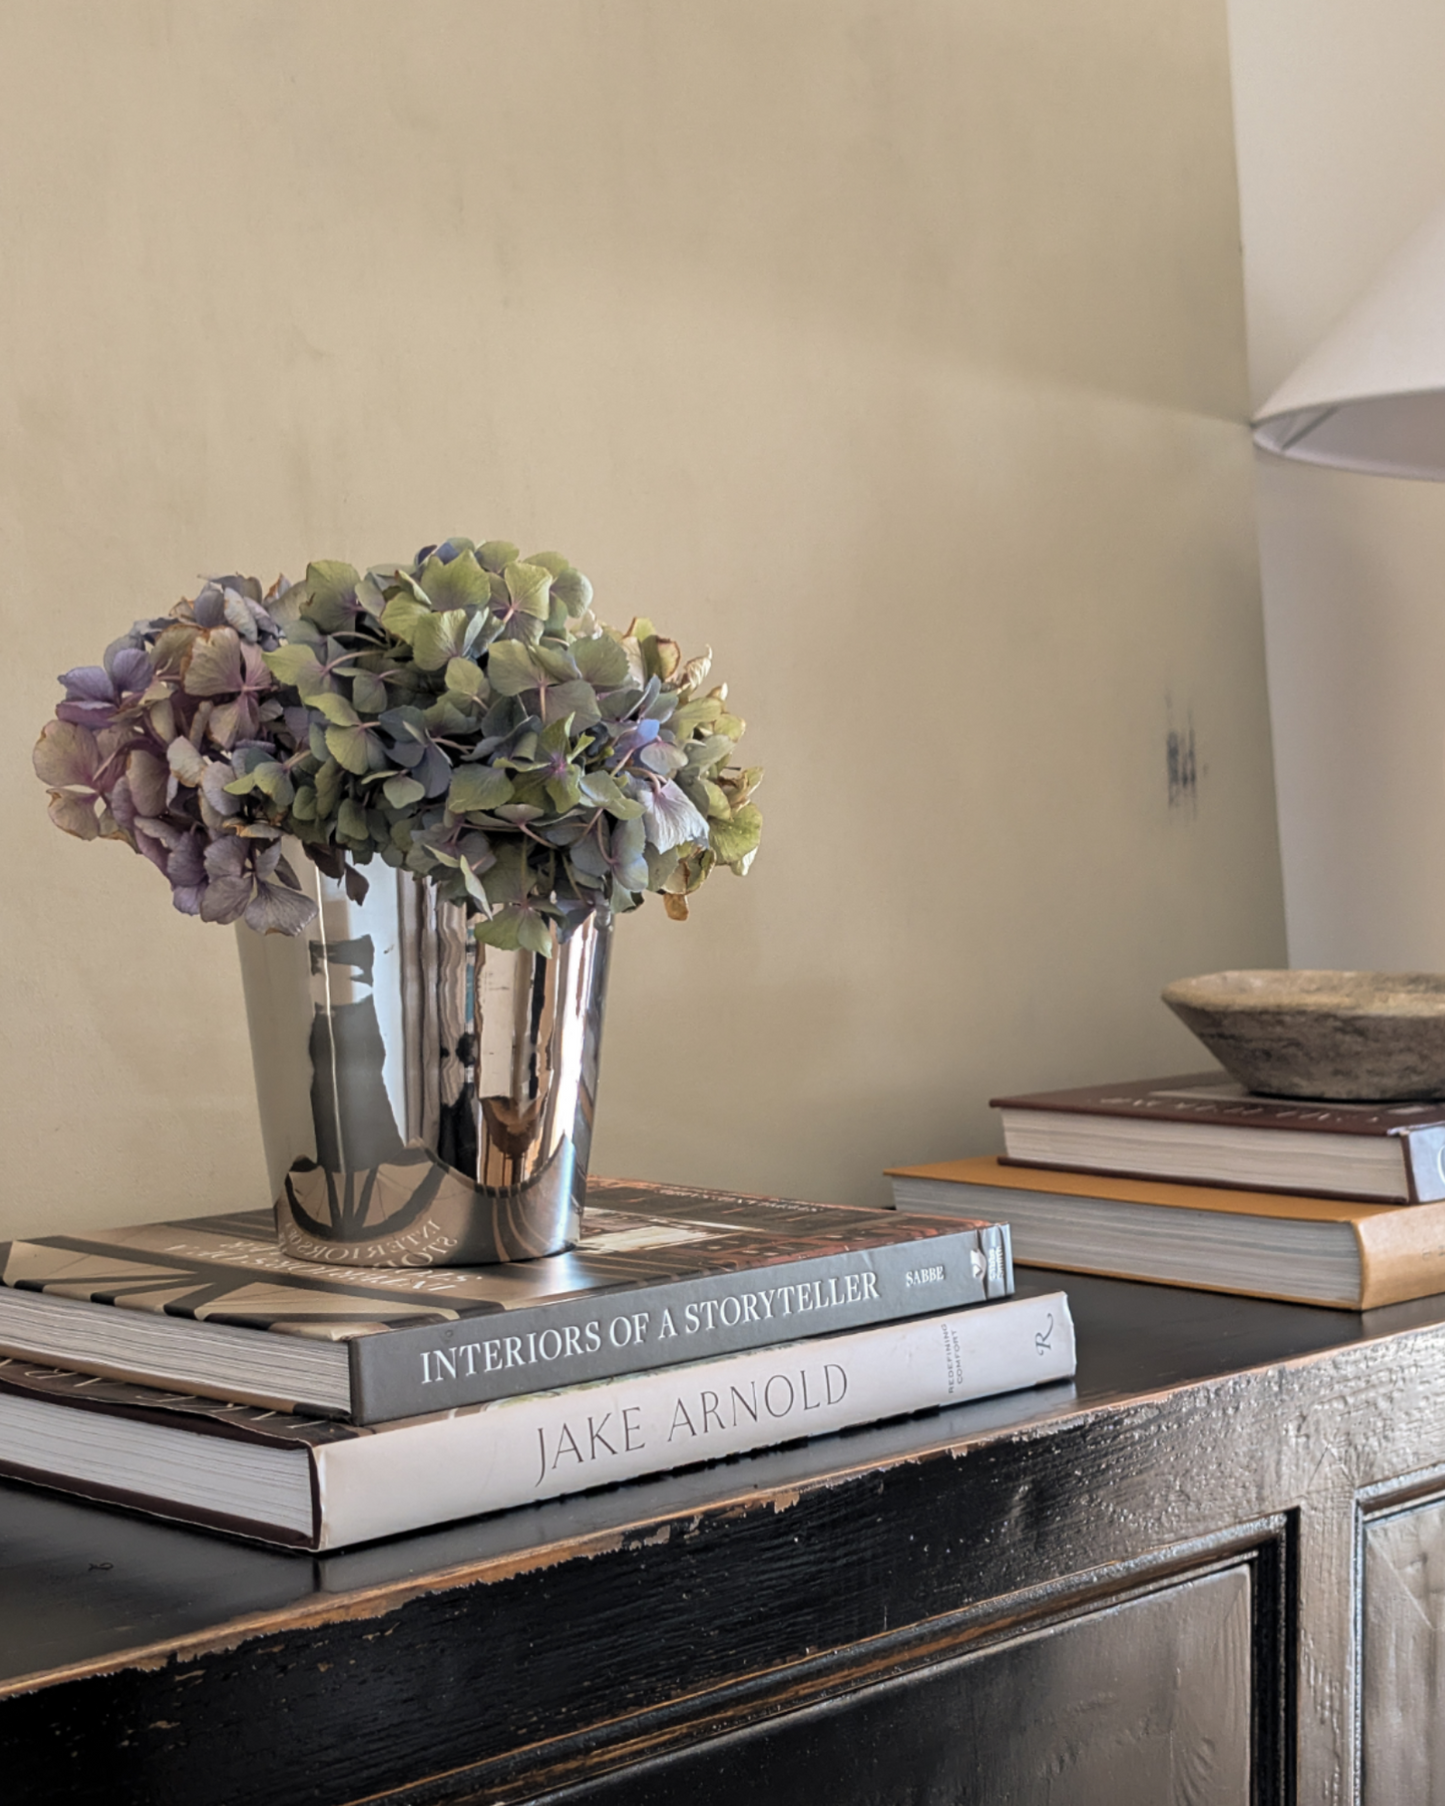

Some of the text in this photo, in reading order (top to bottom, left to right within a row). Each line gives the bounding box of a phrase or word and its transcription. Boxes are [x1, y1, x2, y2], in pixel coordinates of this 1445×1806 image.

[420, 1265, 944, 1385] INTERIORS OF A STORYTELLER SABBE
[940, 1323, 954, 1394] REDEFINING
[951, 1330, 963, 1385] COMFORT
[534, 1363, 848, 1488] JAKE ARNOLD
